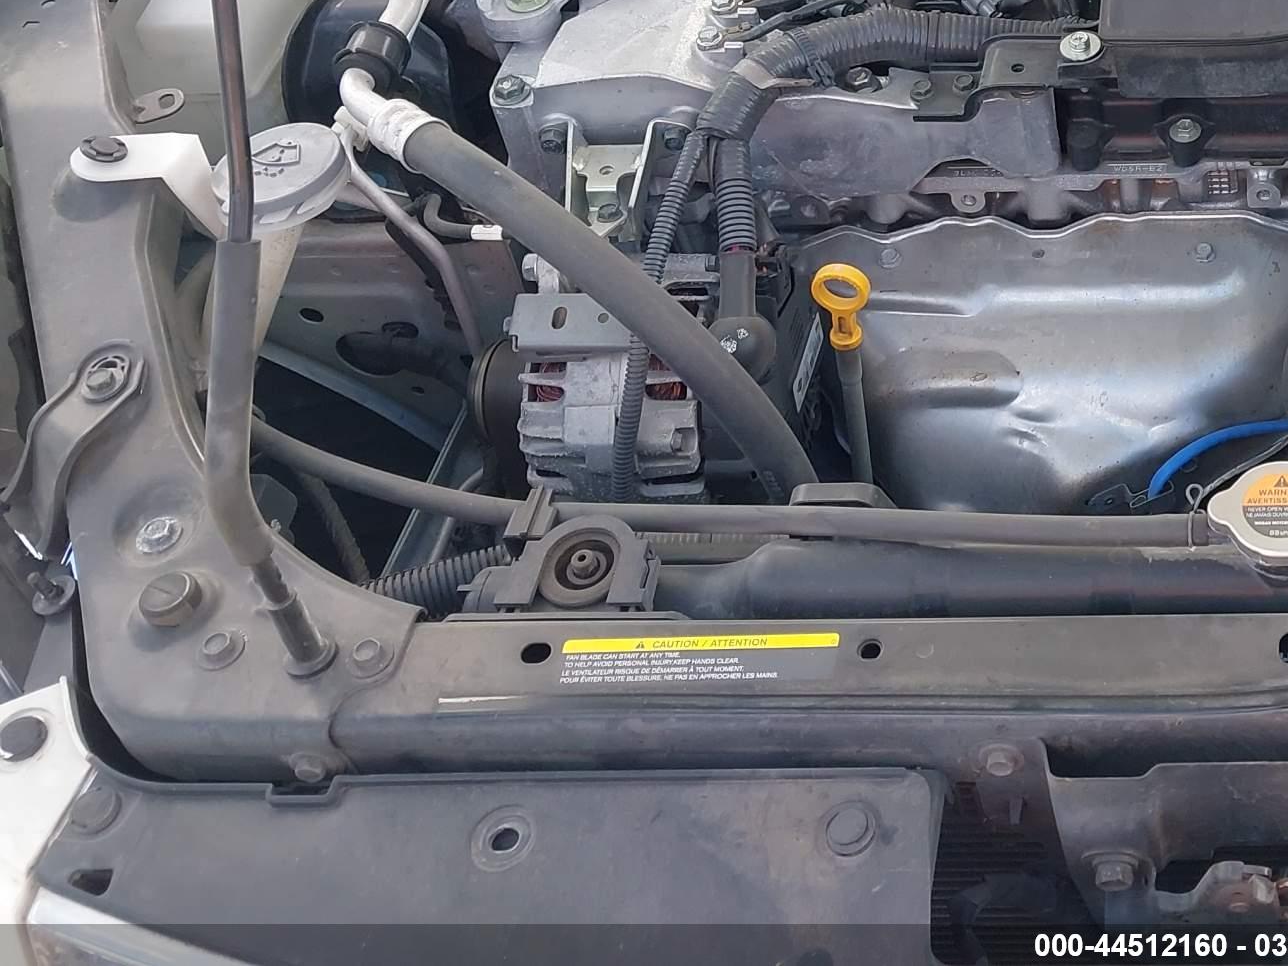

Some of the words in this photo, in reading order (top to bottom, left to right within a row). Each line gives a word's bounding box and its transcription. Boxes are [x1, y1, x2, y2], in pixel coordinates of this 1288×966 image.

[652, 639, 699, 648] CAUTION
[702, 639, 708, 647] /
[710, 638, 768, 647] ATTENTION
[613, 659, 649, 667] PERSONAL
[571, 668, 615, 676] VENTILATEUR
[651, 665, 689, 674] DÉMARRER
[688, 665, 694, 673] À
[580, 675, 603, 683] ÉVITER
